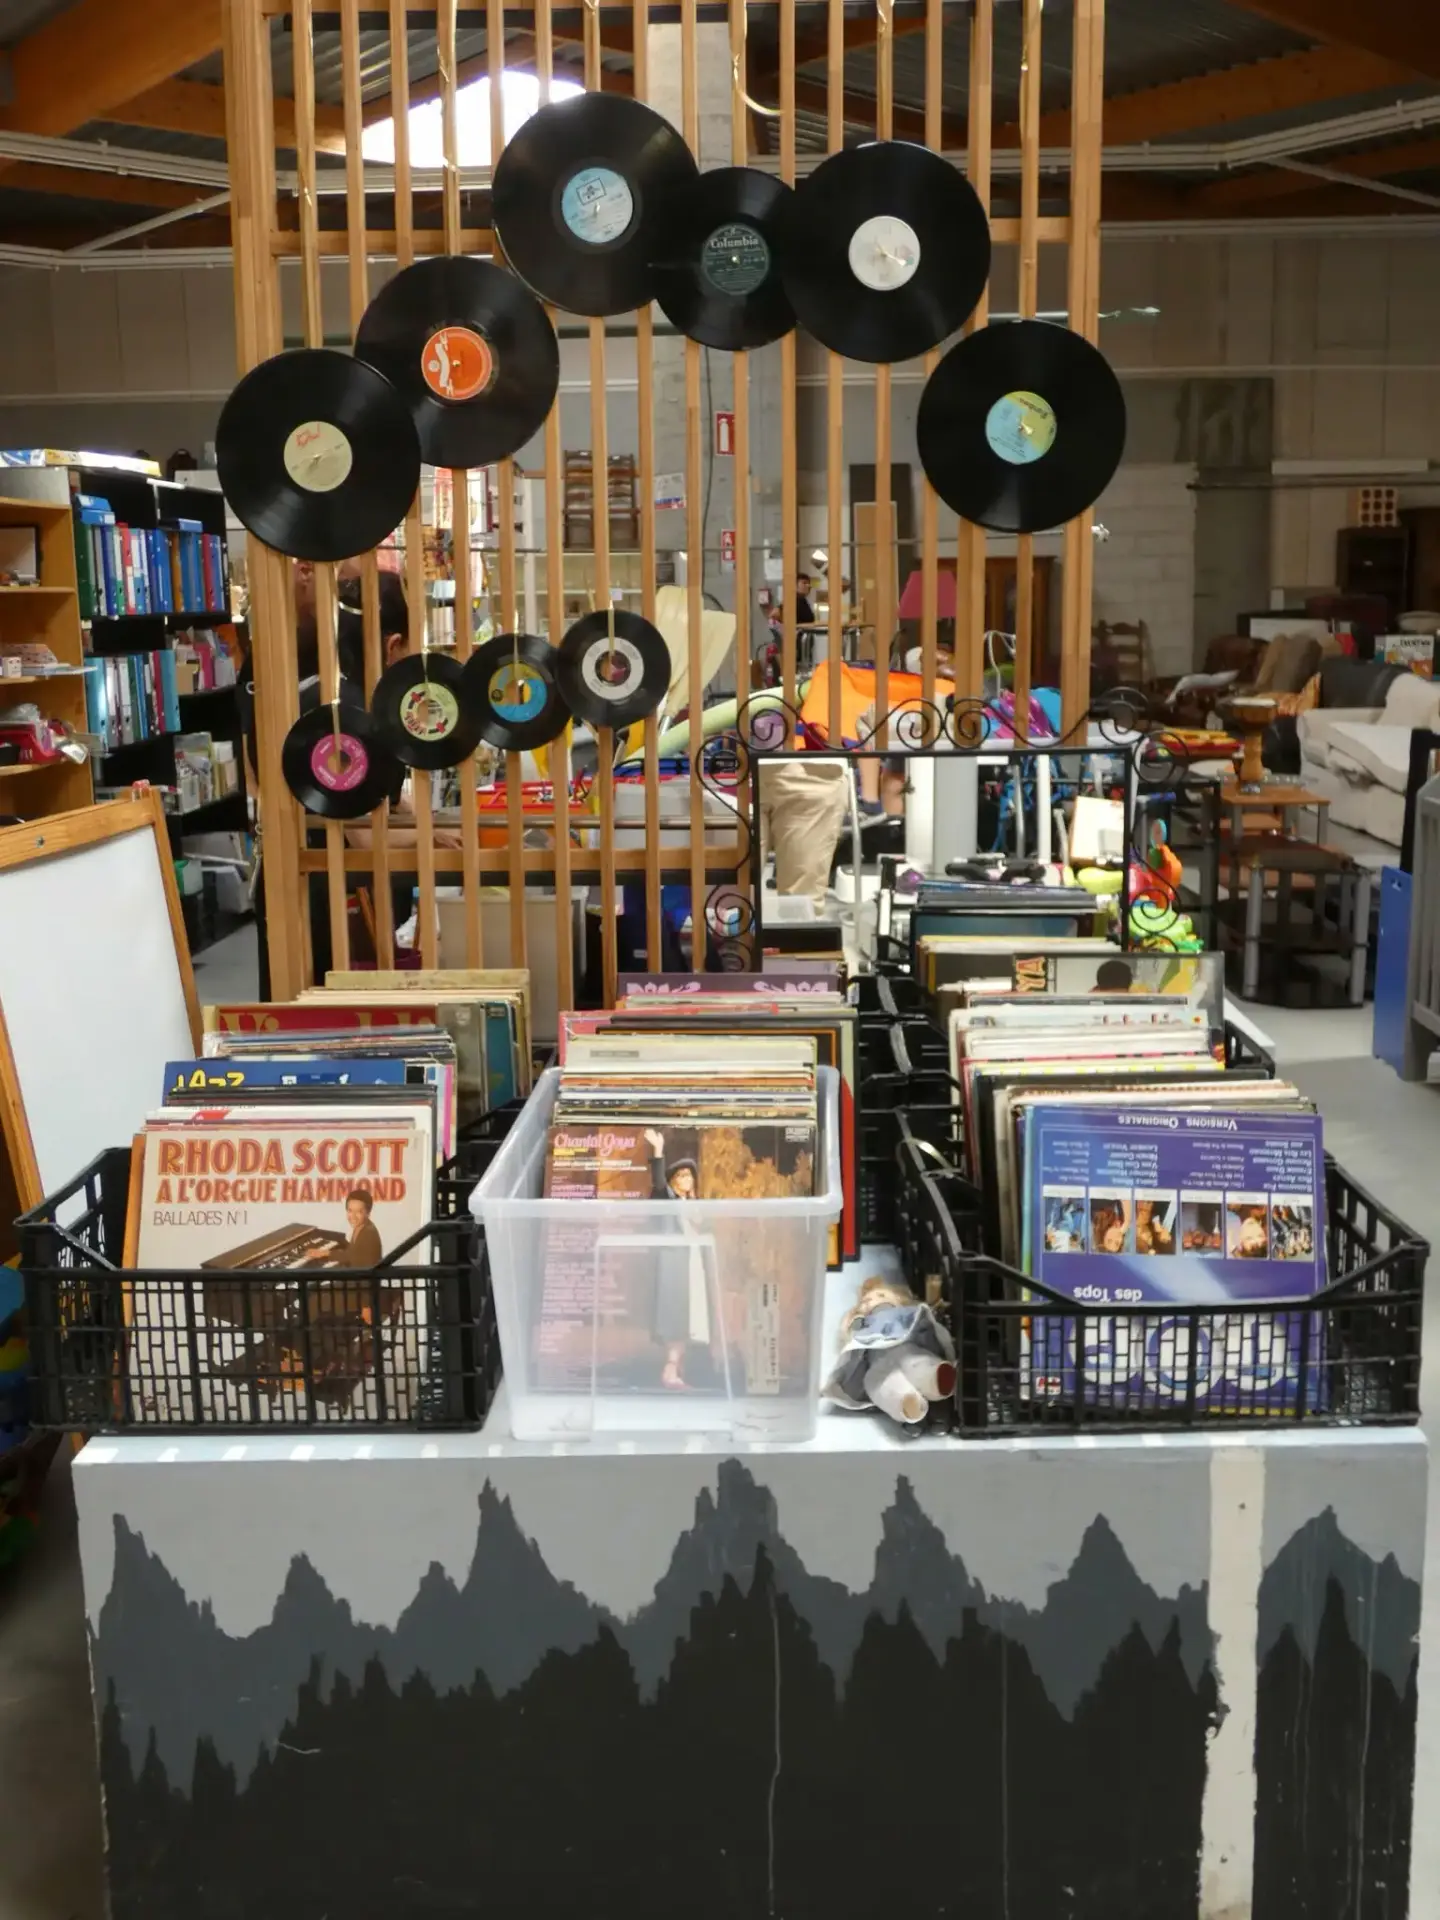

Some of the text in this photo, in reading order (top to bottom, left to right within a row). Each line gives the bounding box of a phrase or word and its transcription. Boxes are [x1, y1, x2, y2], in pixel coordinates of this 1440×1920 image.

[709, 235, 760, 249] Columbia
[1118, 1115, 1238, 1131] VERSIONS ORIGINALES
[554, 1133, 602, 1148] Chantal
[158, 1138, 409, 1176] RHODA SCOTT
[156, 1178, 173, 1204] A
[176, 1177, 278, 1204] L'ORGUE
[153, 1210, 223, 1226] BALLADES
[1073, 1284, 1143, 1303] des Tops
